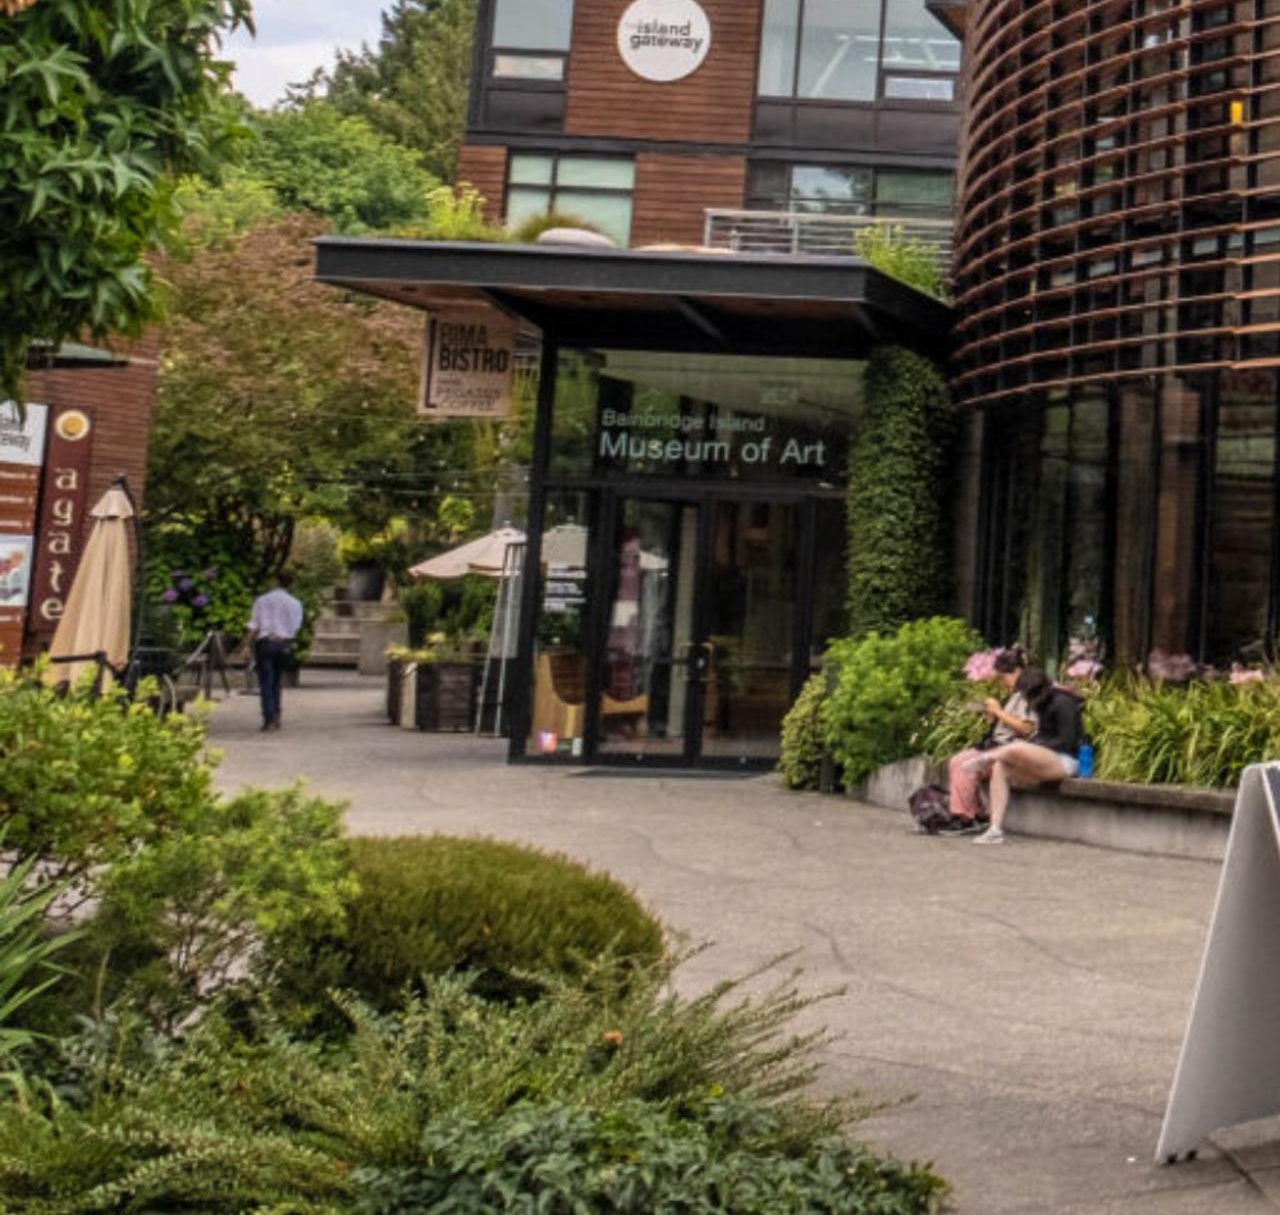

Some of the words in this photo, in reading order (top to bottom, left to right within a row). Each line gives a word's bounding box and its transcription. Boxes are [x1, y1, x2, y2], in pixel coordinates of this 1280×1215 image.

[637, 19, 691, 36] island
[630, 35, 703, 54] gateway
[440, 323, 487, 347] BIMA
[439, 347, 509, 373] BISTRO
[602, 409, 703, 432] Bainbridge
[709, 414, 766, 432] Island
[600, 432, 731, 462] Museum
[741, 437, 771, 463] of
[780, 438, 825, 465] Art
[40, 467, 78, 619] agate
